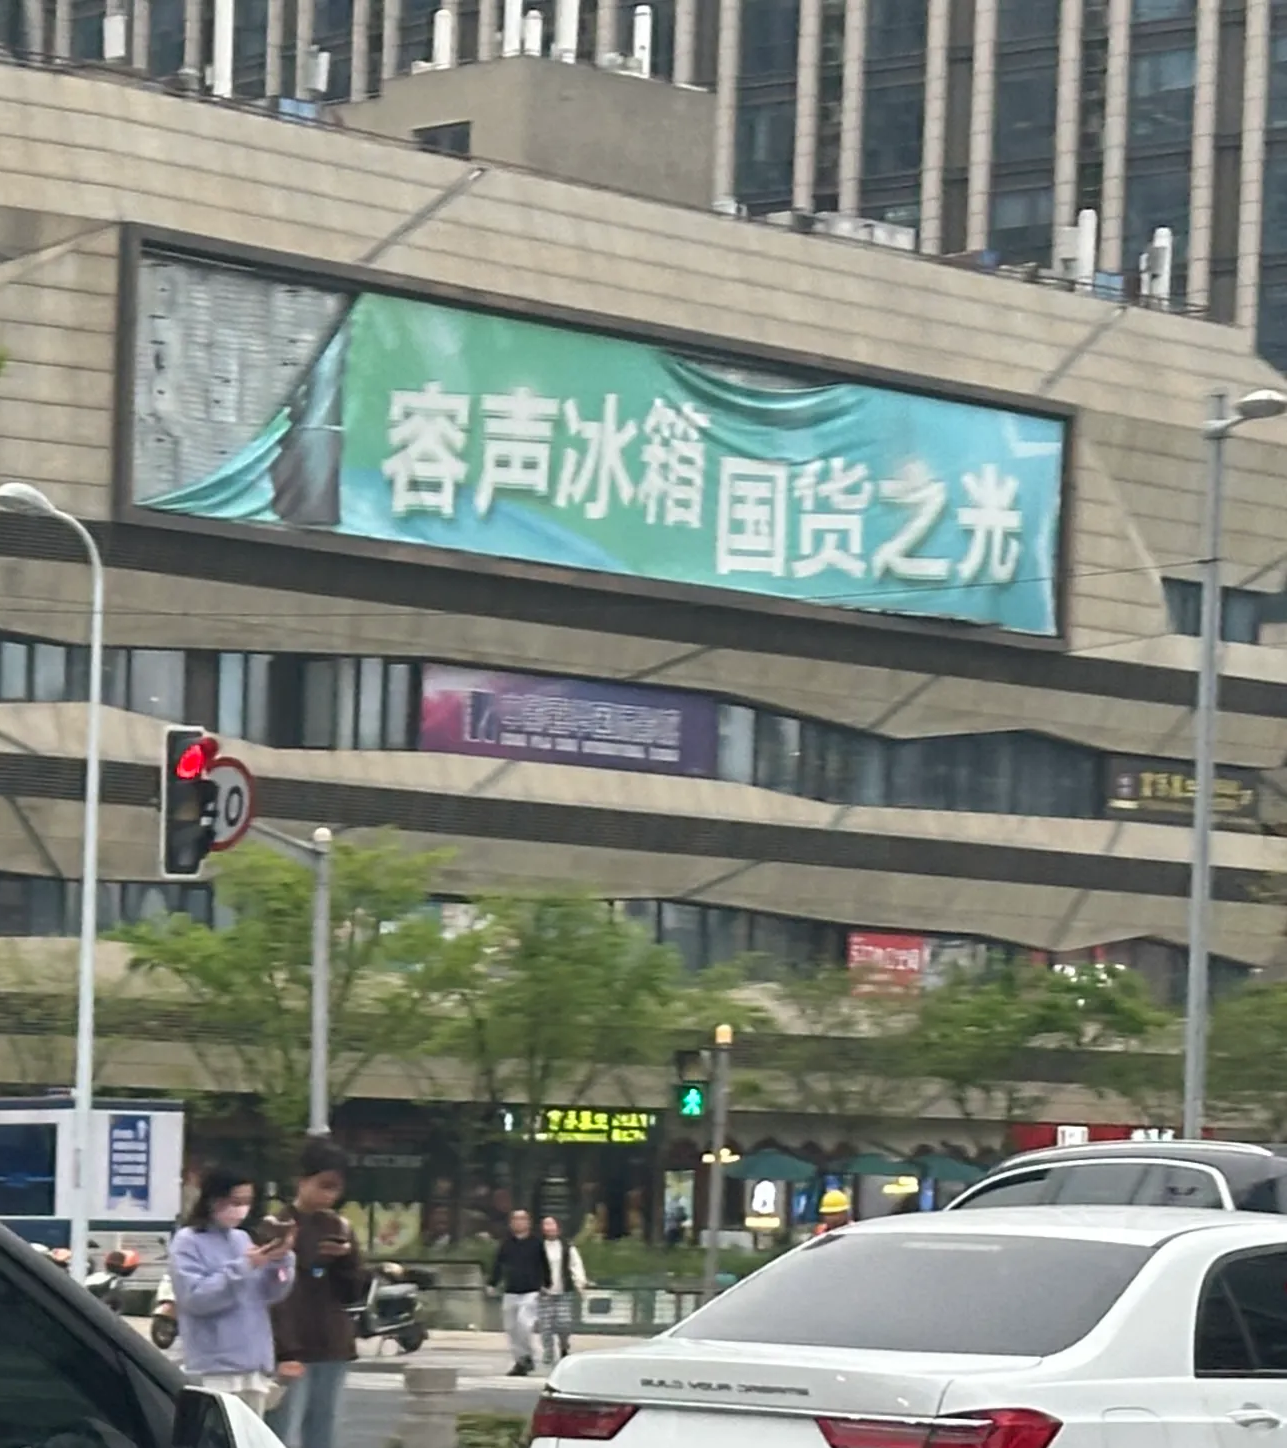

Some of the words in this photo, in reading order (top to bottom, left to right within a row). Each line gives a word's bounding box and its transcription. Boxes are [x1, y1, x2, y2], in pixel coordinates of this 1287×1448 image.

[381, 380, 714, 530] 容声冰箱
[714, 456, 1023, 584] 国货之光
